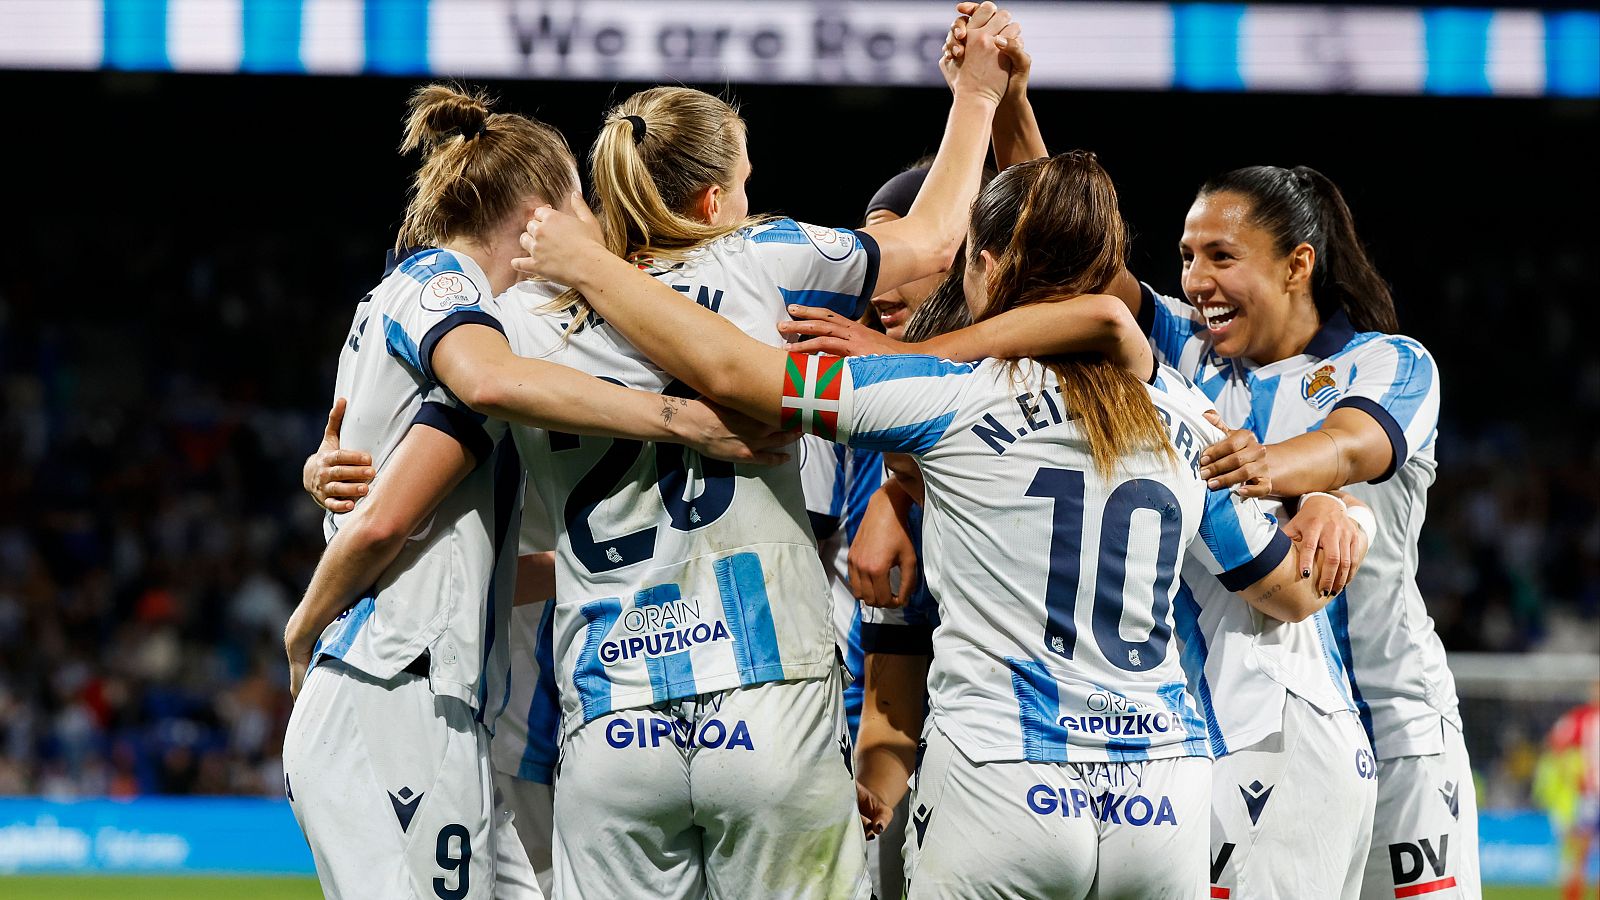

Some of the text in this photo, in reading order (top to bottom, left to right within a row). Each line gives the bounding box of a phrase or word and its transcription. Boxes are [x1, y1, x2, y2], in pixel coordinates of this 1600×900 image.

[507, 7, 629, 58] We
[656, 26, 785, 60] are
[1024, 466, 1183, 673] 10
[600, 620, 731, 663] GIPUZKOA
[624, 600, 700, 632] ORAIN
[1059, 712, 1184, 736] GIPUZKOA
[432, 823, 472, 900] 9
[1388, 834, 1449, 886] DV
